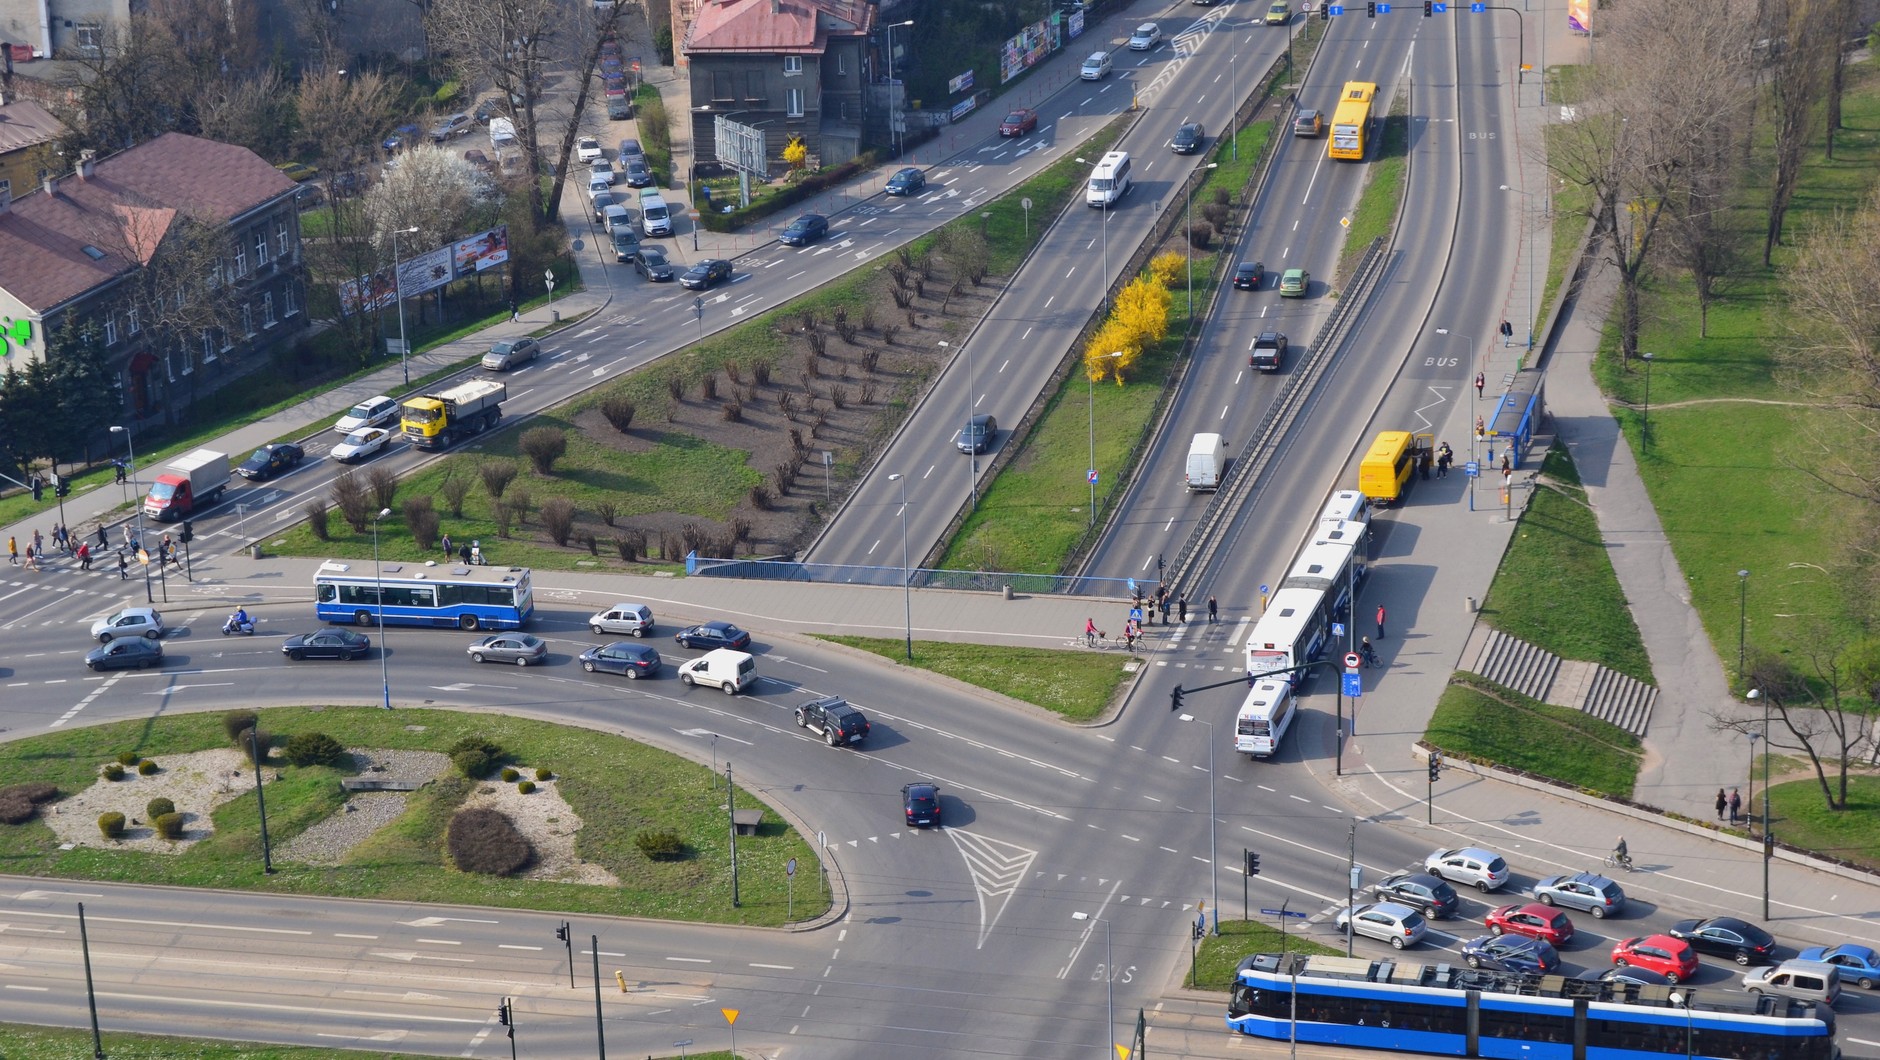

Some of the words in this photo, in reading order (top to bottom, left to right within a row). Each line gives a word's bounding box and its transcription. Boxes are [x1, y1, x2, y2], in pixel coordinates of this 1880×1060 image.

[1468, 132, 1497, 140] BUS
[852, 206, 885, 215] BUS
[734, 257, 769, 267] BUS
[1423, 356, 1459, 367] BUS
[1091, 963, 1137, 984] BUS
